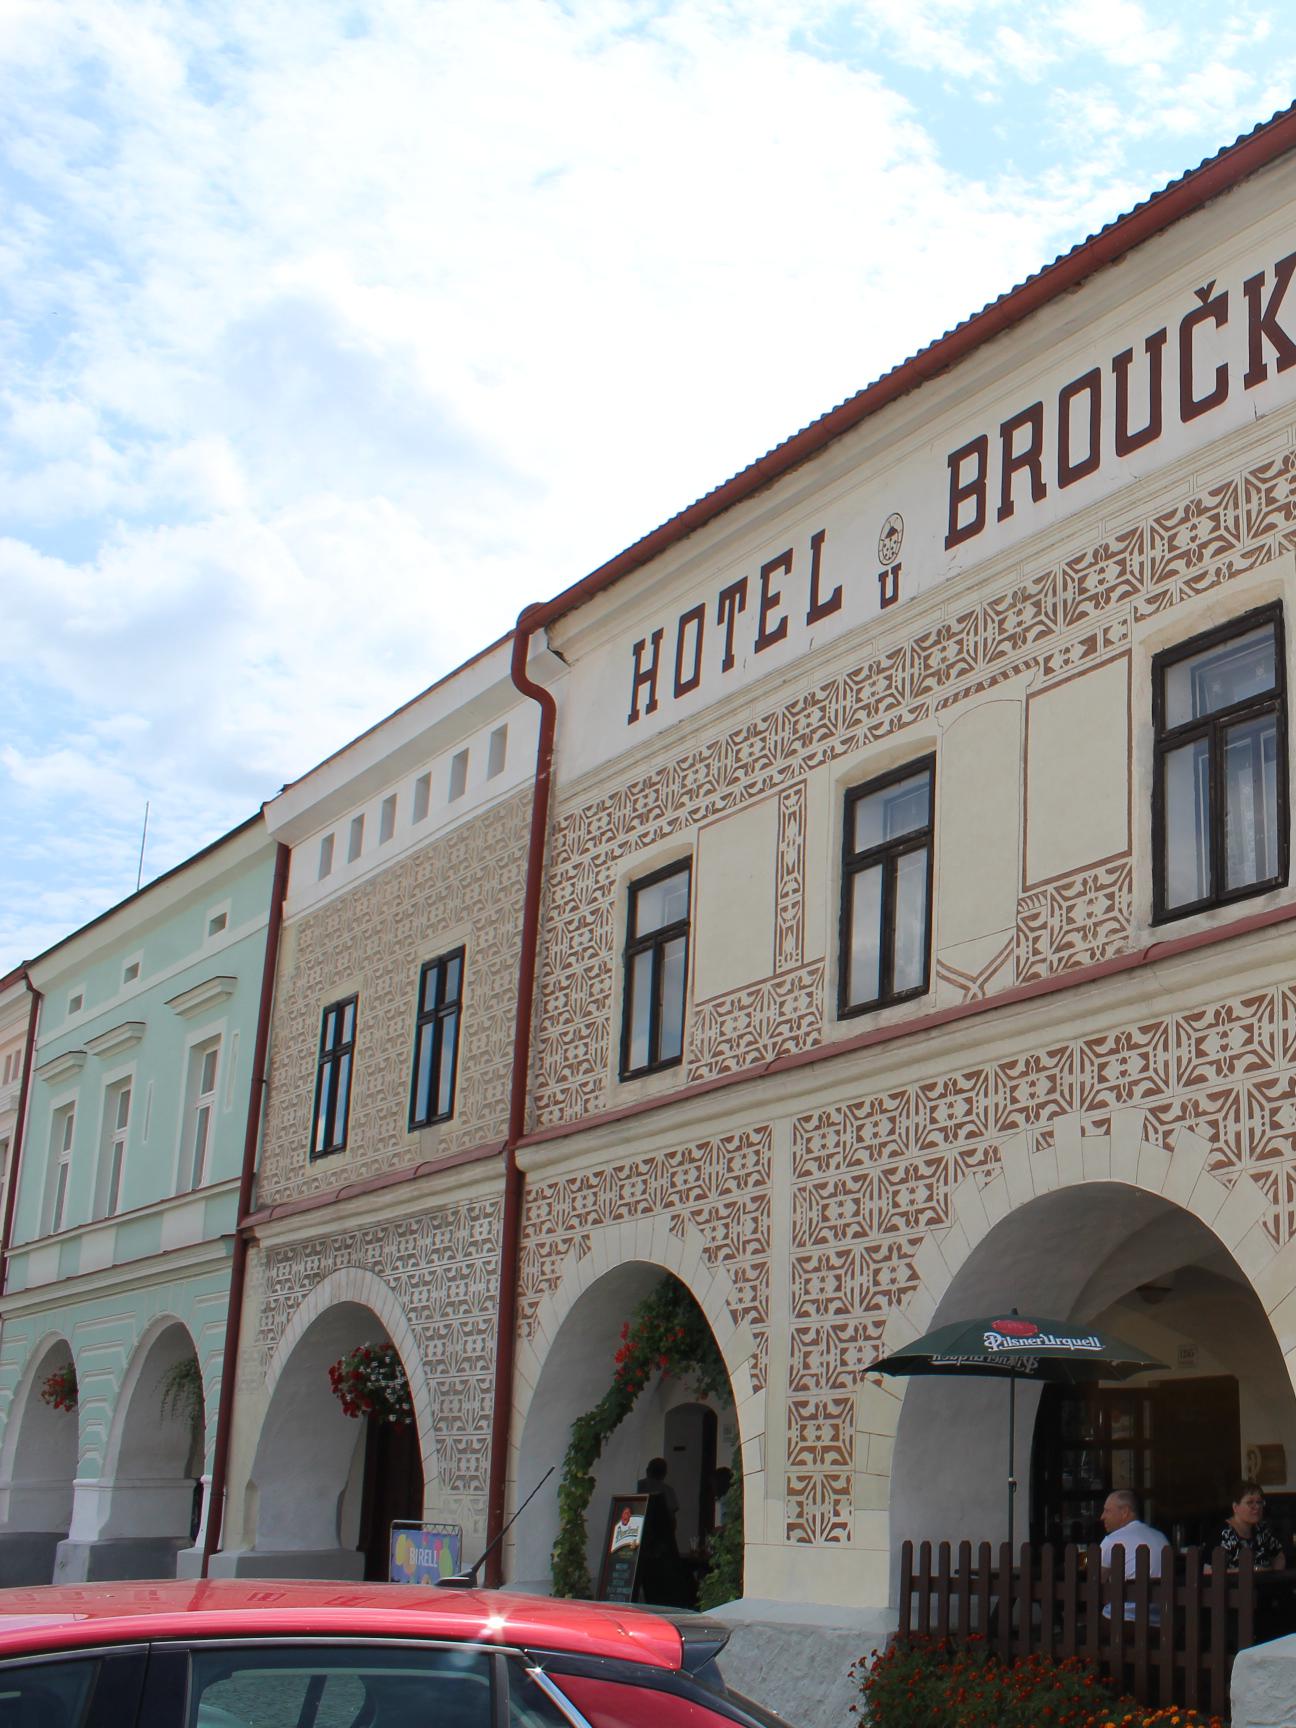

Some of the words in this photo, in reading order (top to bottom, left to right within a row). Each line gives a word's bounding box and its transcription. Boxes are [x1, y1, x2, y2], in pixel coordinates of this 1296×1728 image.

[628, 529, 842, 725] HOTEL
[984, 1331, 1043, 1352] Pilsner
[1040, 1334, 1102, 1351] Urquell
[409, 1547, 438, 1567] BIRELL
